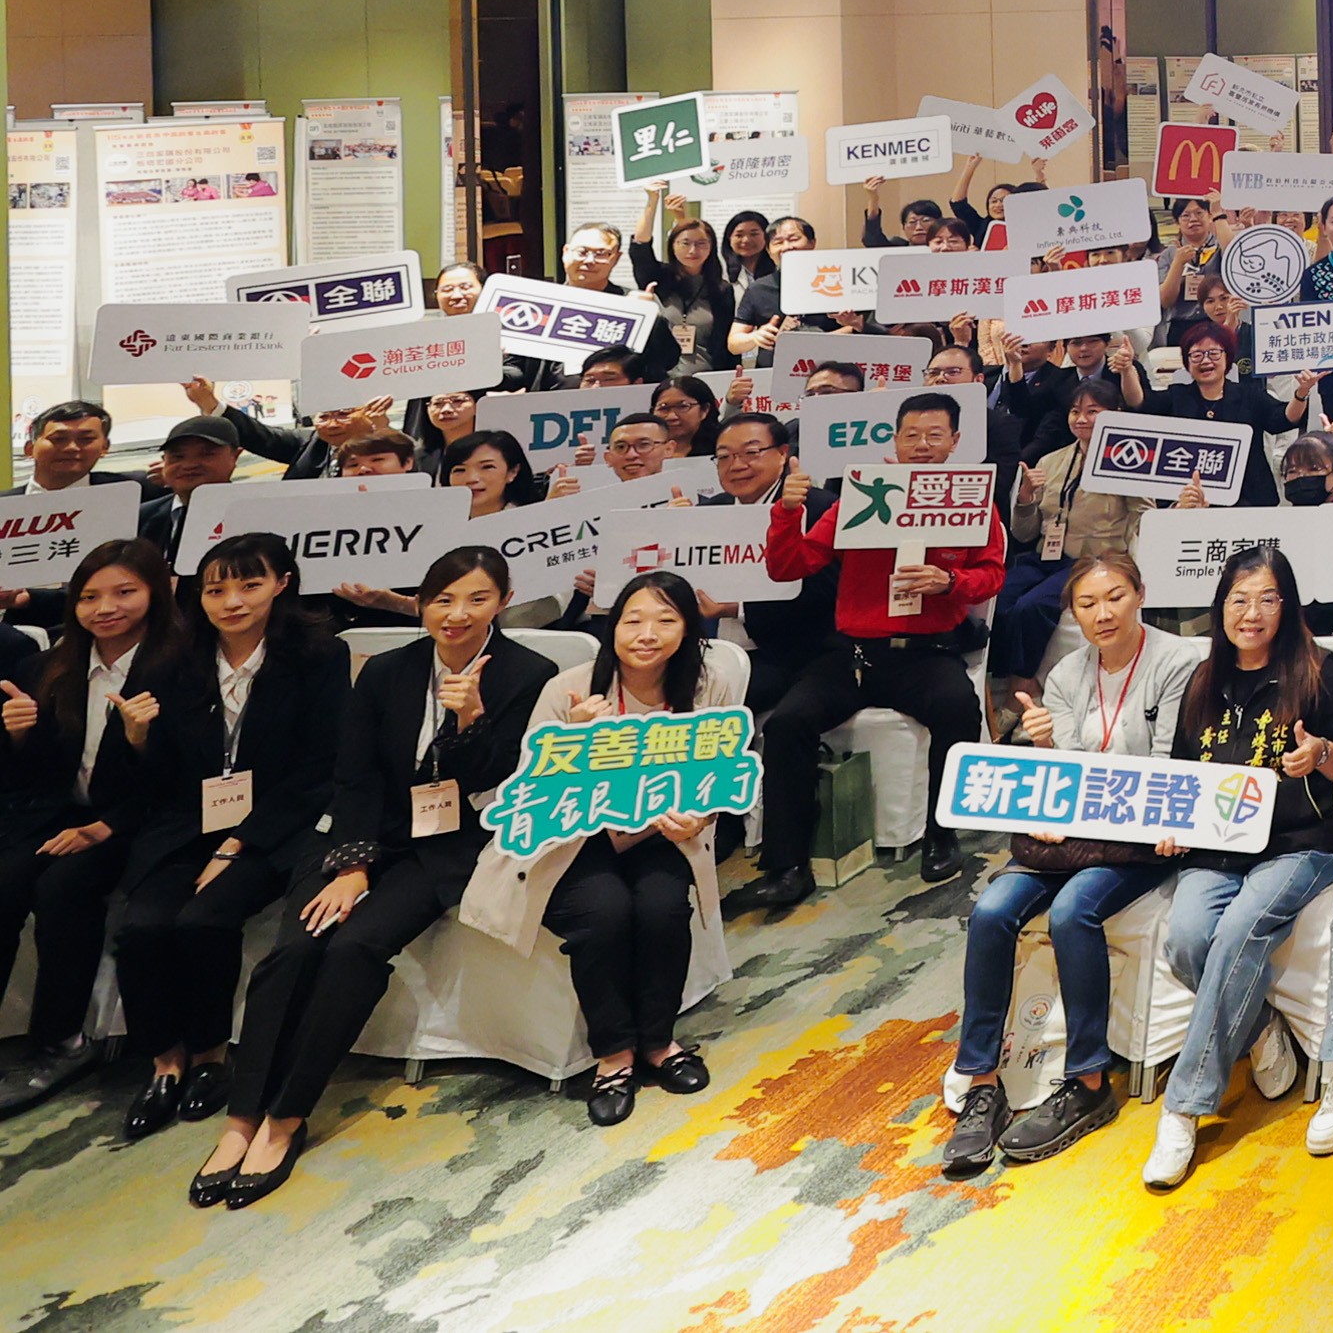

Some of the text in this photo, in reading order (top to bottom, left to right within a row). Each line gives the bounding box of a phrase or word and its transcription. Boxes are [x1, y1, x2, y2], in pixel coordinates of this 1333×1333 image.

[629, 121, 694, 162] 里仁
[1038, 118, 1079, 150] 萊爾富
[729, 155, 792, 171] 碩隆精密
[846, 138, 931, 161] KENMEC
[728, 167, 789, 181] Shou Long
[322, 277, 398, 311] 全聯
[1056, 287, 1143, 314] 摩斯漢堡
[557, 313, 628, 346] 全聯
[1273, 310, 1331, 330] ATEN
[163, 344, 184, 353] Far
[255, 341, 284, 351] Bank
[382, 339, 465, 366] 瀚荃集團
[427, 357, 466, 372] Group
[529, 408, 621, 451] DFI
[1163, 446, 1226, 475] 全聯
[910, 472, 989, 507] 愛買
[895, 510, 989, 529] a.mart
[8, 538, 81, 566] 三洋
[674, 542, 769, 566] LITEMAX
[1175, 565, 1215, 579] Simple
[1217, 709, 1232, 745] 主任
[530, 716, 743, 778] 友善無齡
[495, 762, 750, 849] 青銀同行
[960, 760, 1202, 831] 新北認證
